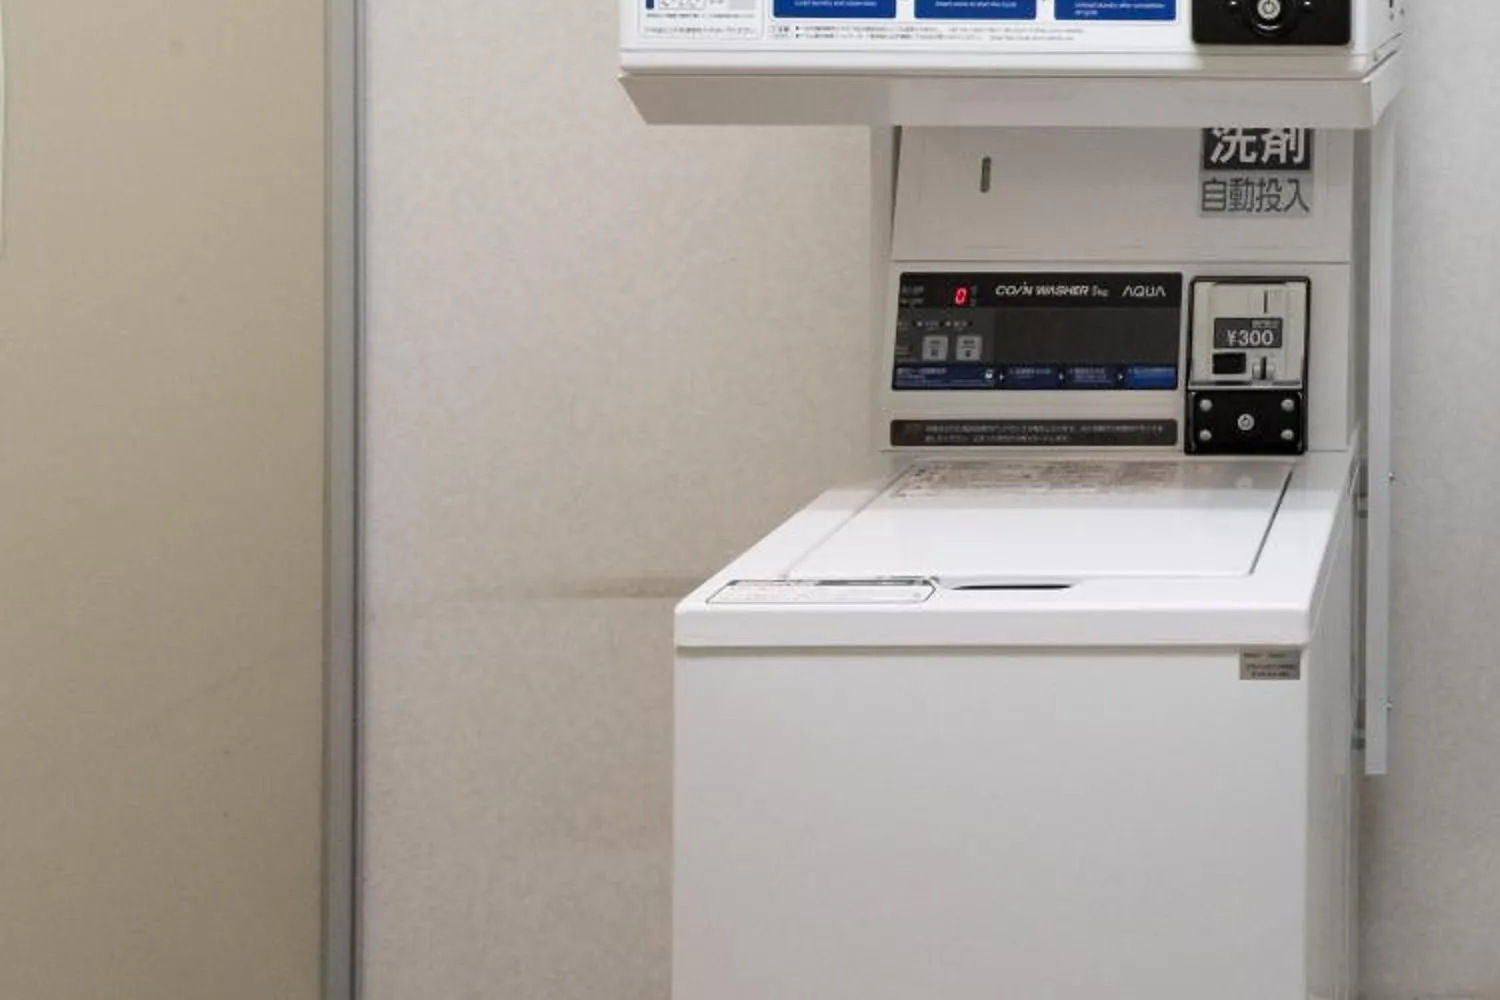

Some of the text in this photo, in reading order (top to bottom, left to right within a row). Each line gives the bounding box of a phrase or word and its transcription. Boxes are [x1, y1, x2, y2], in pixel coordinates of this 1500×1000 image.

[1210, 127, 1305, 164] 洗剤
[1201, 176, 1311, 213] 自動投入
[1035, 284, 1090, 297] WASHER
[1121, 284, 1168, 298] AQUA
[1226, 328, 1275, 347] ¥300
